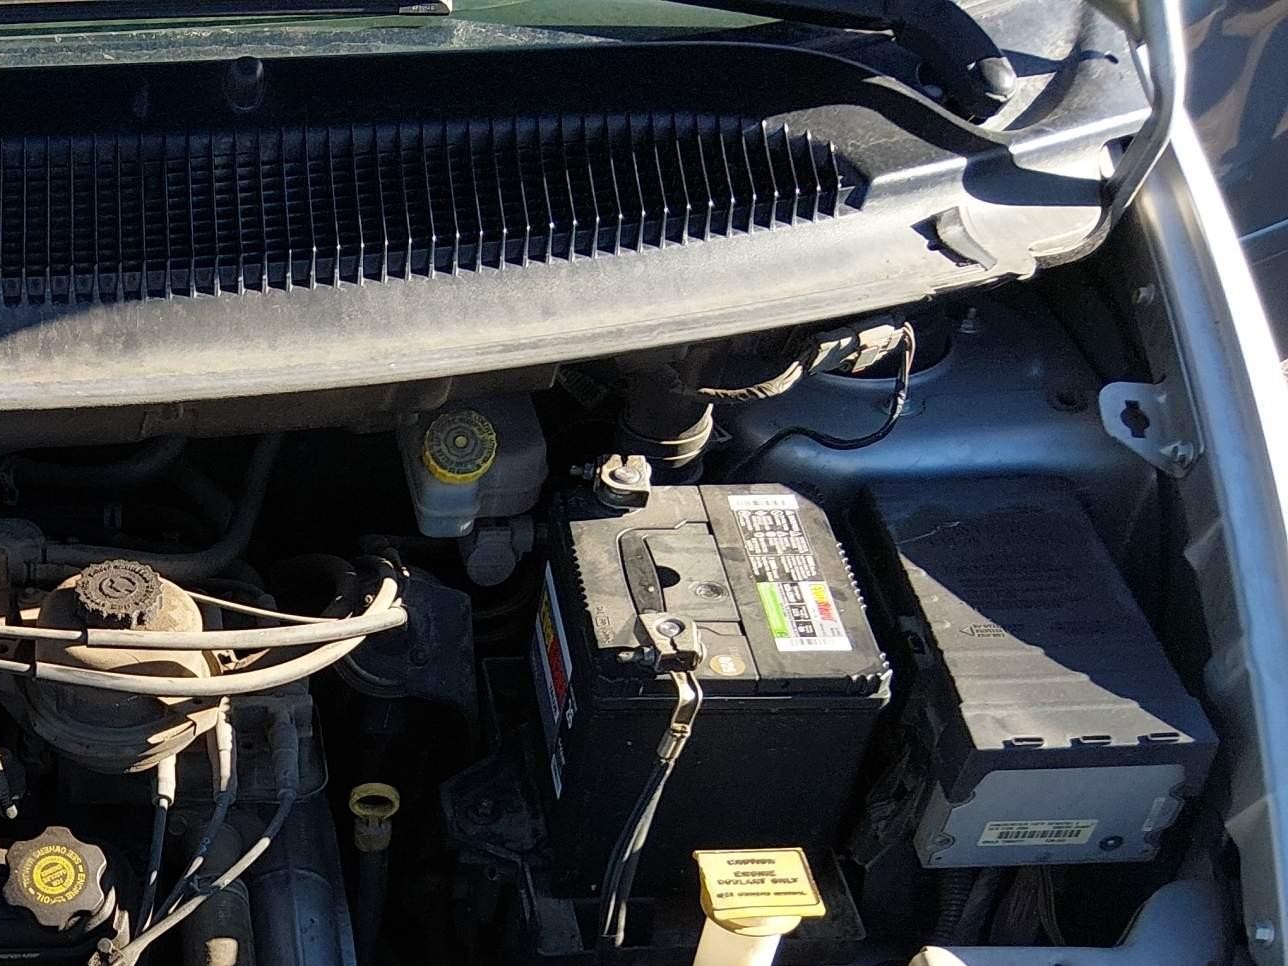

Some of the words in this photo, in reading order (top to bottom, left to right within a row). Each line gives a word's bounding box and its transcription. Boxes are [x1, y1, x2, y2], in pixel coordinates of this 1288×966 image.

[66, 849, 82, 864] SEE
[66, 873, 86, 900] ENGINE
[36, 891, 50, 904] OIL
